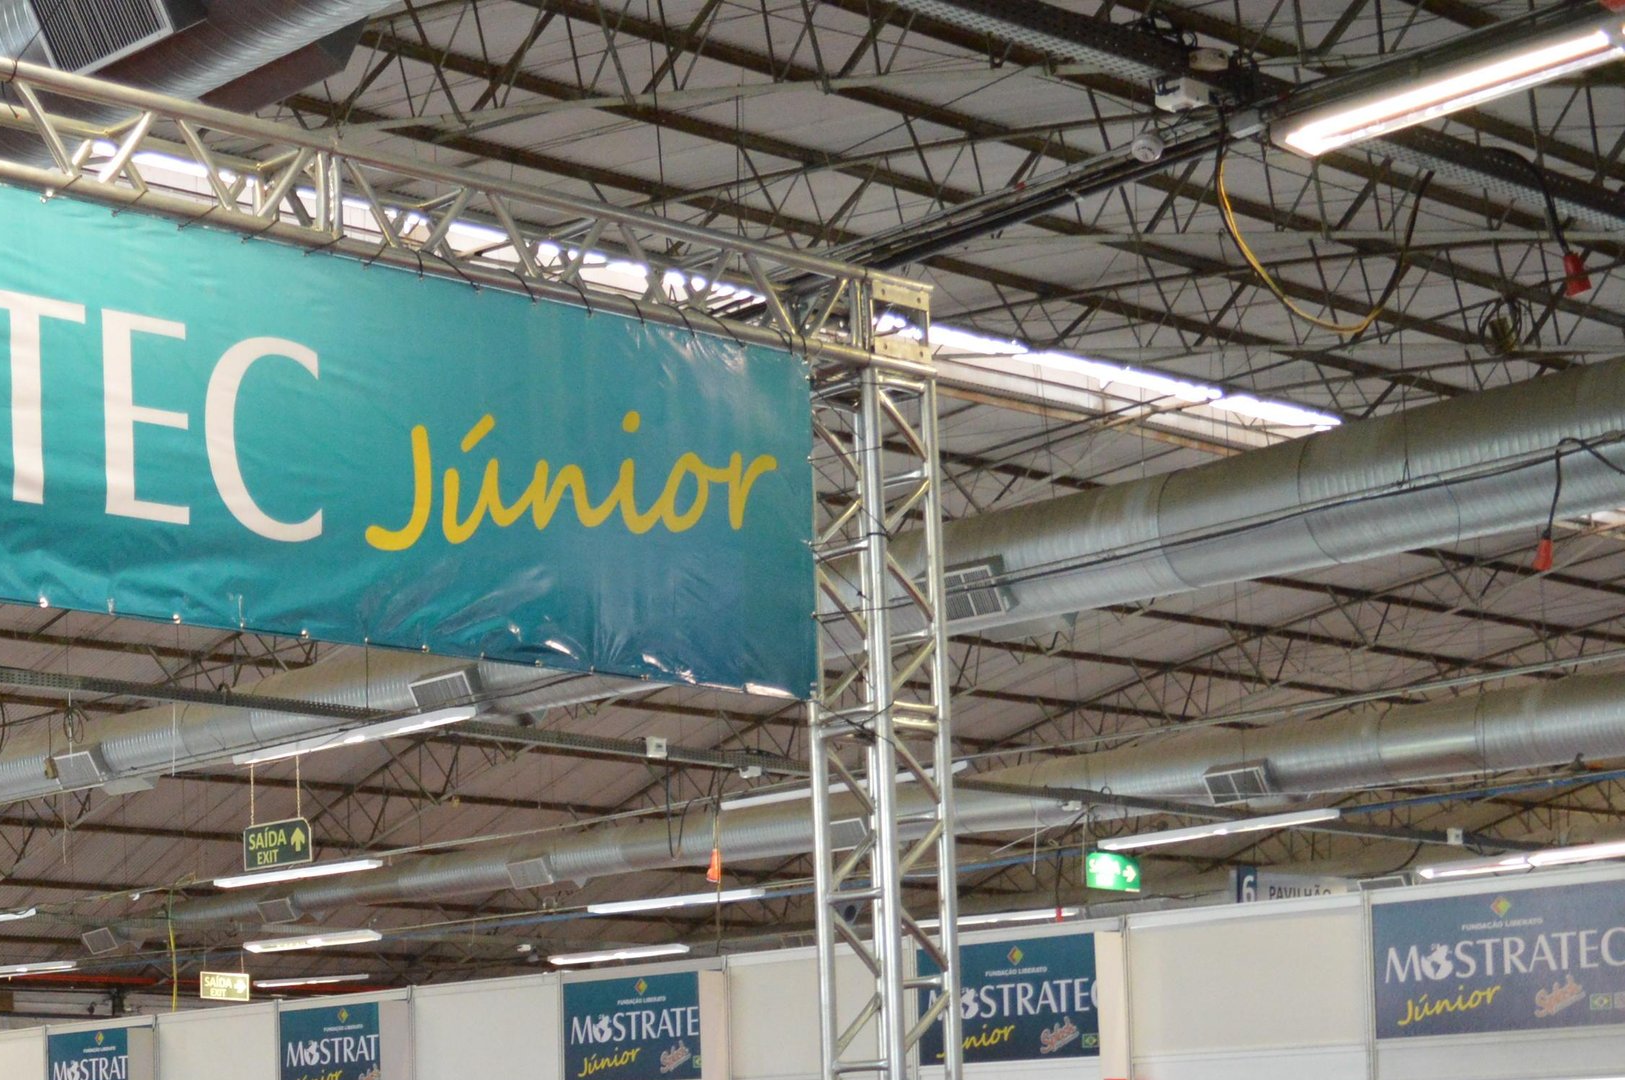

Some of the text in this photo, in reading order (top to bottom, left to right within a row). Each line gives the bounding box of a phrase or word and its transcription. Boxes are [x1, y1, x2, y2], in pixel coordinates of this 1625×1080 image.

[365, 410, 777, 552] Júnior
[248, 826, 287, 851] SAÍDA
[257, 848, 279, 865] EXIT
[1242, 874, 1257, 901] 6
[1384, 926, 1625, 984] MOSTRATEC
[204, 975, 233, 989] SAÍDA
[210, 988, 227, 998] EXIT
[1397, 984, 1502, 1026] Júnior
[570, 1006, 700, 1046] MOSTRATE
[286, 1034, 380, 1068] MOSTRAT
[578, 1046, 642, 1078] Júnior
